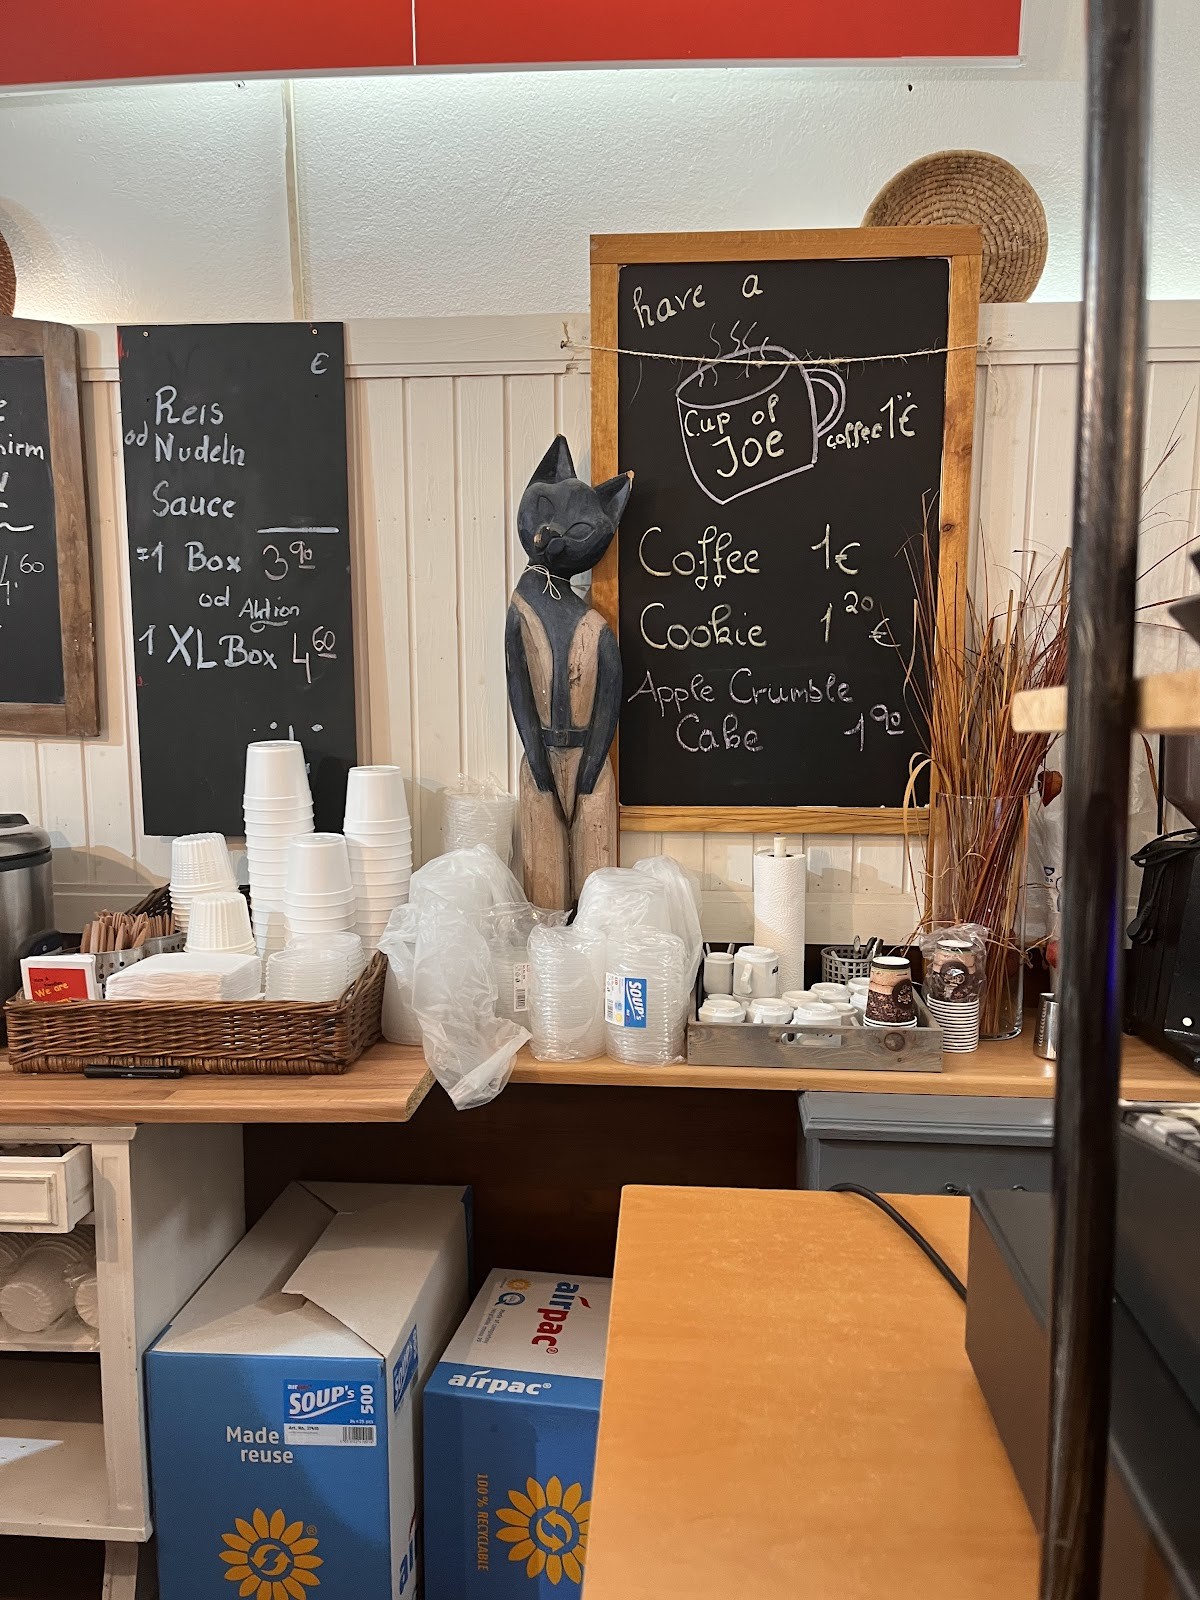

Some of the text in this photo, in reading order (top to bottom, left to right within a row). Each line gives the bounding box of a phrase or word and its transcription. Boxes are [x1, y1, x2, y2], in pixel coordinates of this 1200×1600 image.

[633, 274, 763, 329] have a
[310, 352, 329, 374] €
[155, 385, 225, 426] Reis
[684, 409, 731, 437] Cup
[124, 421, 246, 467] od Nudeln
[151, 480, 236, 518] Sauce
[185, 541, 241, 573] Box
[639, 526, 760, 591] Coffee
[199, 586, 230, 607] od
[639, 602, 767, 650] Cookie
[138, 625, 155, 656] 1
[166, 624, 219, 670] XL
[219, 634, 277, 670] Box
[627, 668, 854, 717] Apple Crumble
[676, 713, 763, 752] Cake
[34, 988, 52, 998] We
[54, 982, 69, 992] are
[289, 1385, 355, 1415] SOUP's
[360, 1384, 374, 1414] 500
[226, 1426, 280, 1445] Made
[240, 1449, 294, 1464] reuse
[477, 1511, 489, 1572] RECYCLABLE
